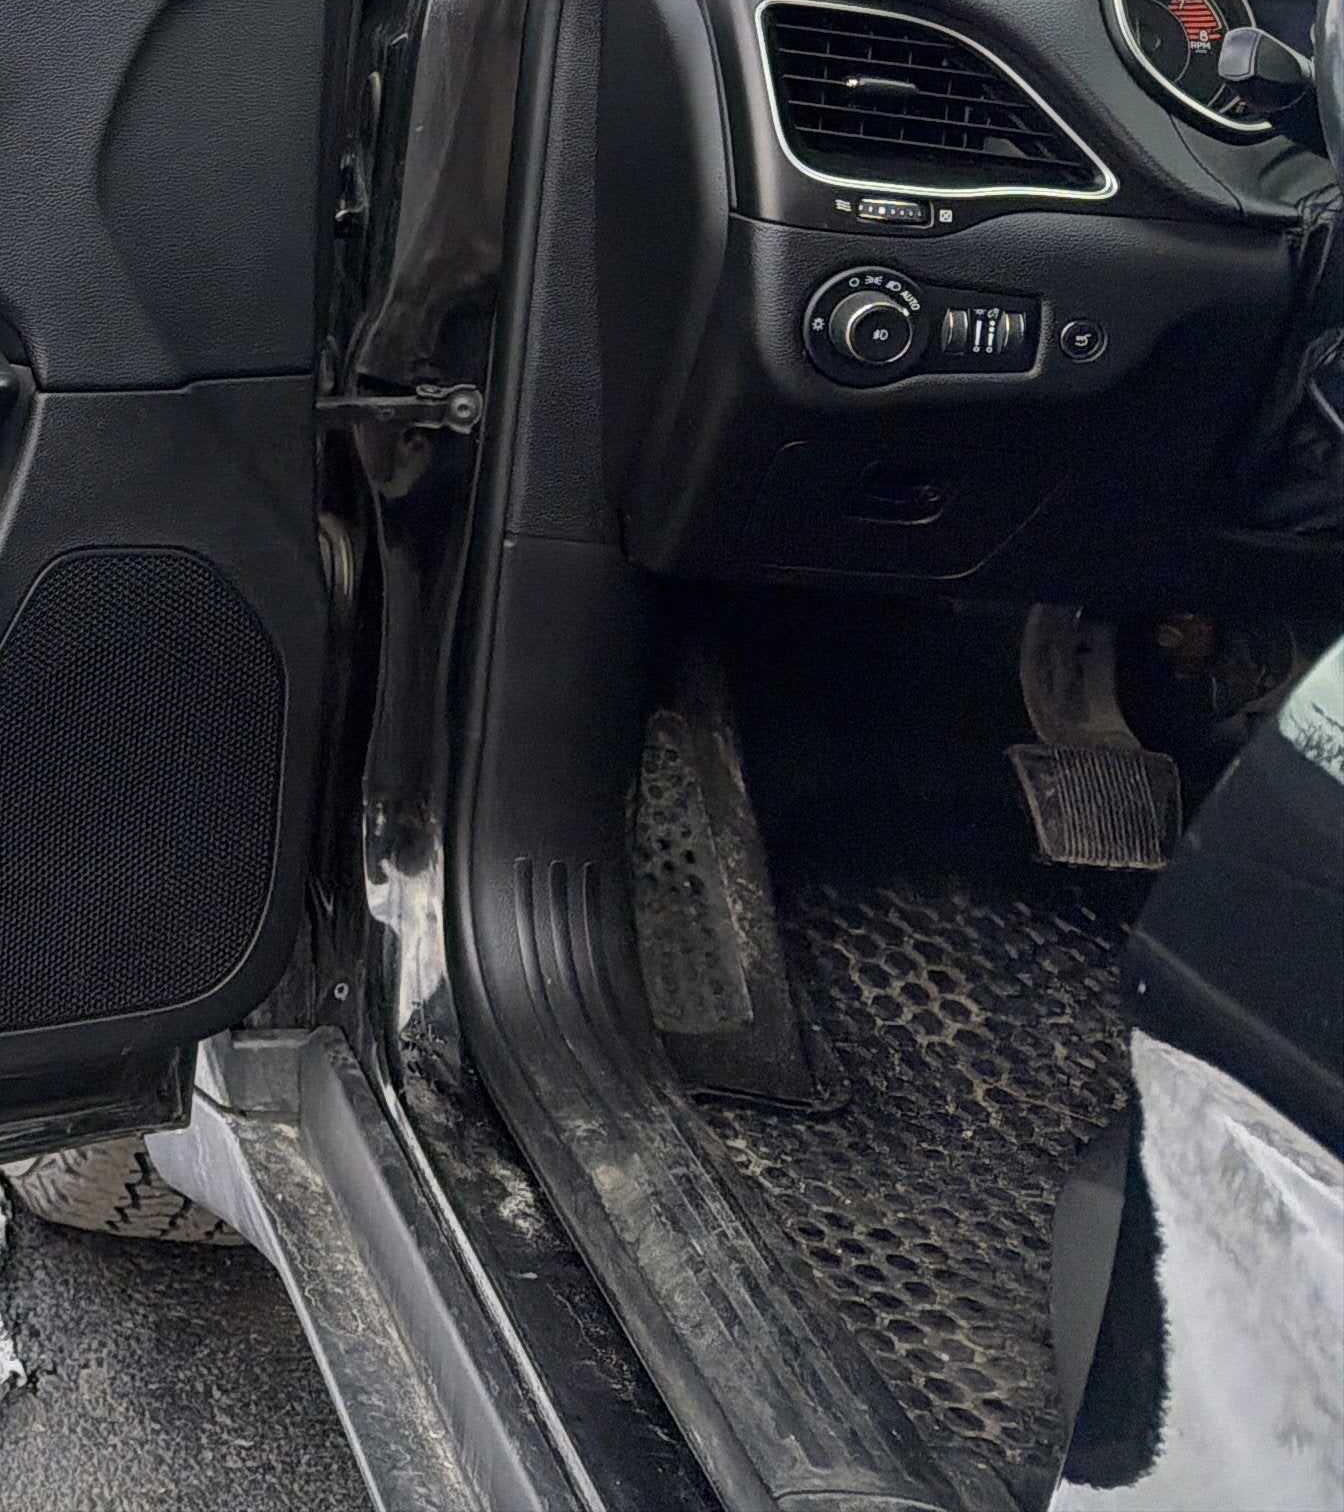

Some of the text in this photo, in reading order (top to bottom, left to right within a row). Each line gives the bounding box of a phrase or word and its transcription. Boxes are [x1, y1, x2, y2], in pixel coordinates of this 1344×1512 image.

[1199, 30, 1209, 42] 8
[1190, 42, 1212, 50] RPM
[899, 290, 921, 311] AUTO
